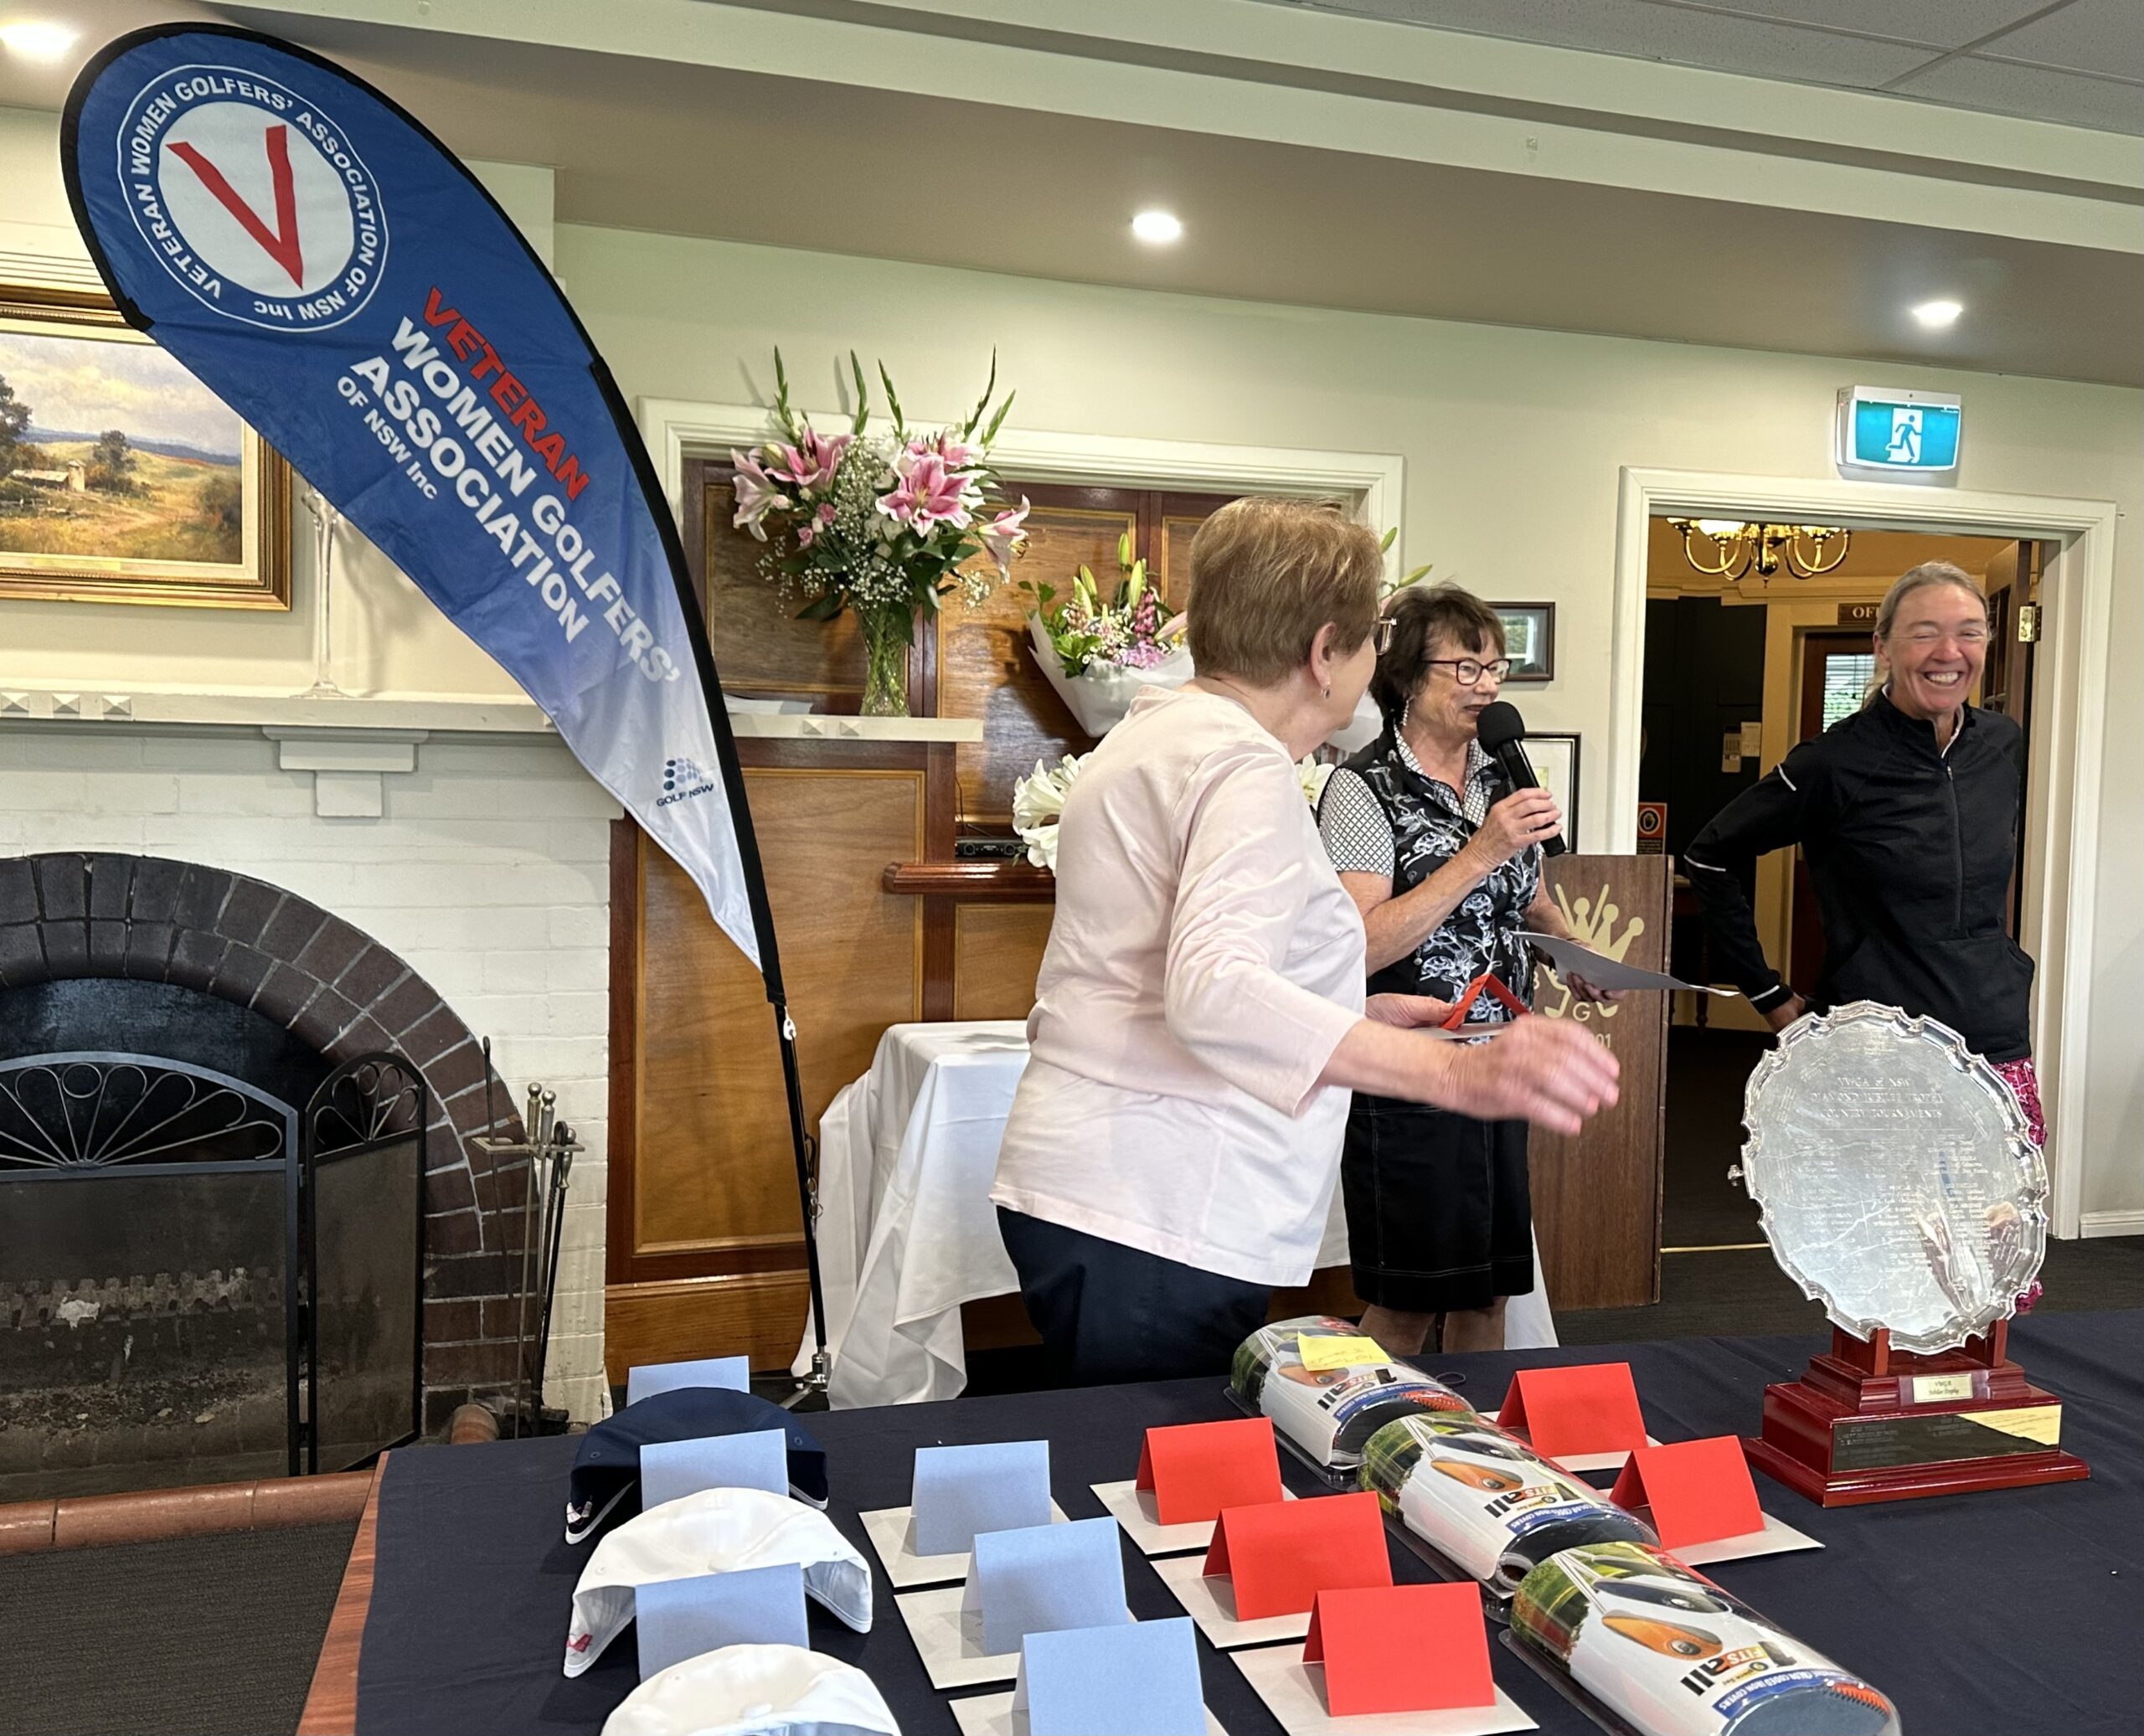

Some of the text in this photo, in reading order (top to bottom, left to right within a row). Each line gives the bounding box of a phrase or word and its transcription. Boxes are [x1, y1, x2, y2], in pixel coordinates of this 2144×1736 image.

[131, 91, 178, 177] WOMEN
[165, 124, 304, 291] V
[296, 111, 379, 266] ASSOCIATION
[134, 183, 222, 300] VETERAN
[345, 267, 368, 299] OF
[253, 300, 293, 321] Inc
[301, 290, 347, 321] NSW
[390, 315, 538, 497] WOMEN
[422, 286, 590, 501] VETERAN
[337, 375, 438, 501] OF NSW Inc
[349, 355, 590, 644] ASSOCIATION
[656, 783, 714, 807] GOLF NSW
[1572, 1002, 1590, 1022] G
[1483, 1491, 1525, 1519] all
[1680, 1656, 1732, 1697] all
[1726, 1648, 1766, 1666] FITS
[1718, 1687, 1747, 1711] COVERS
